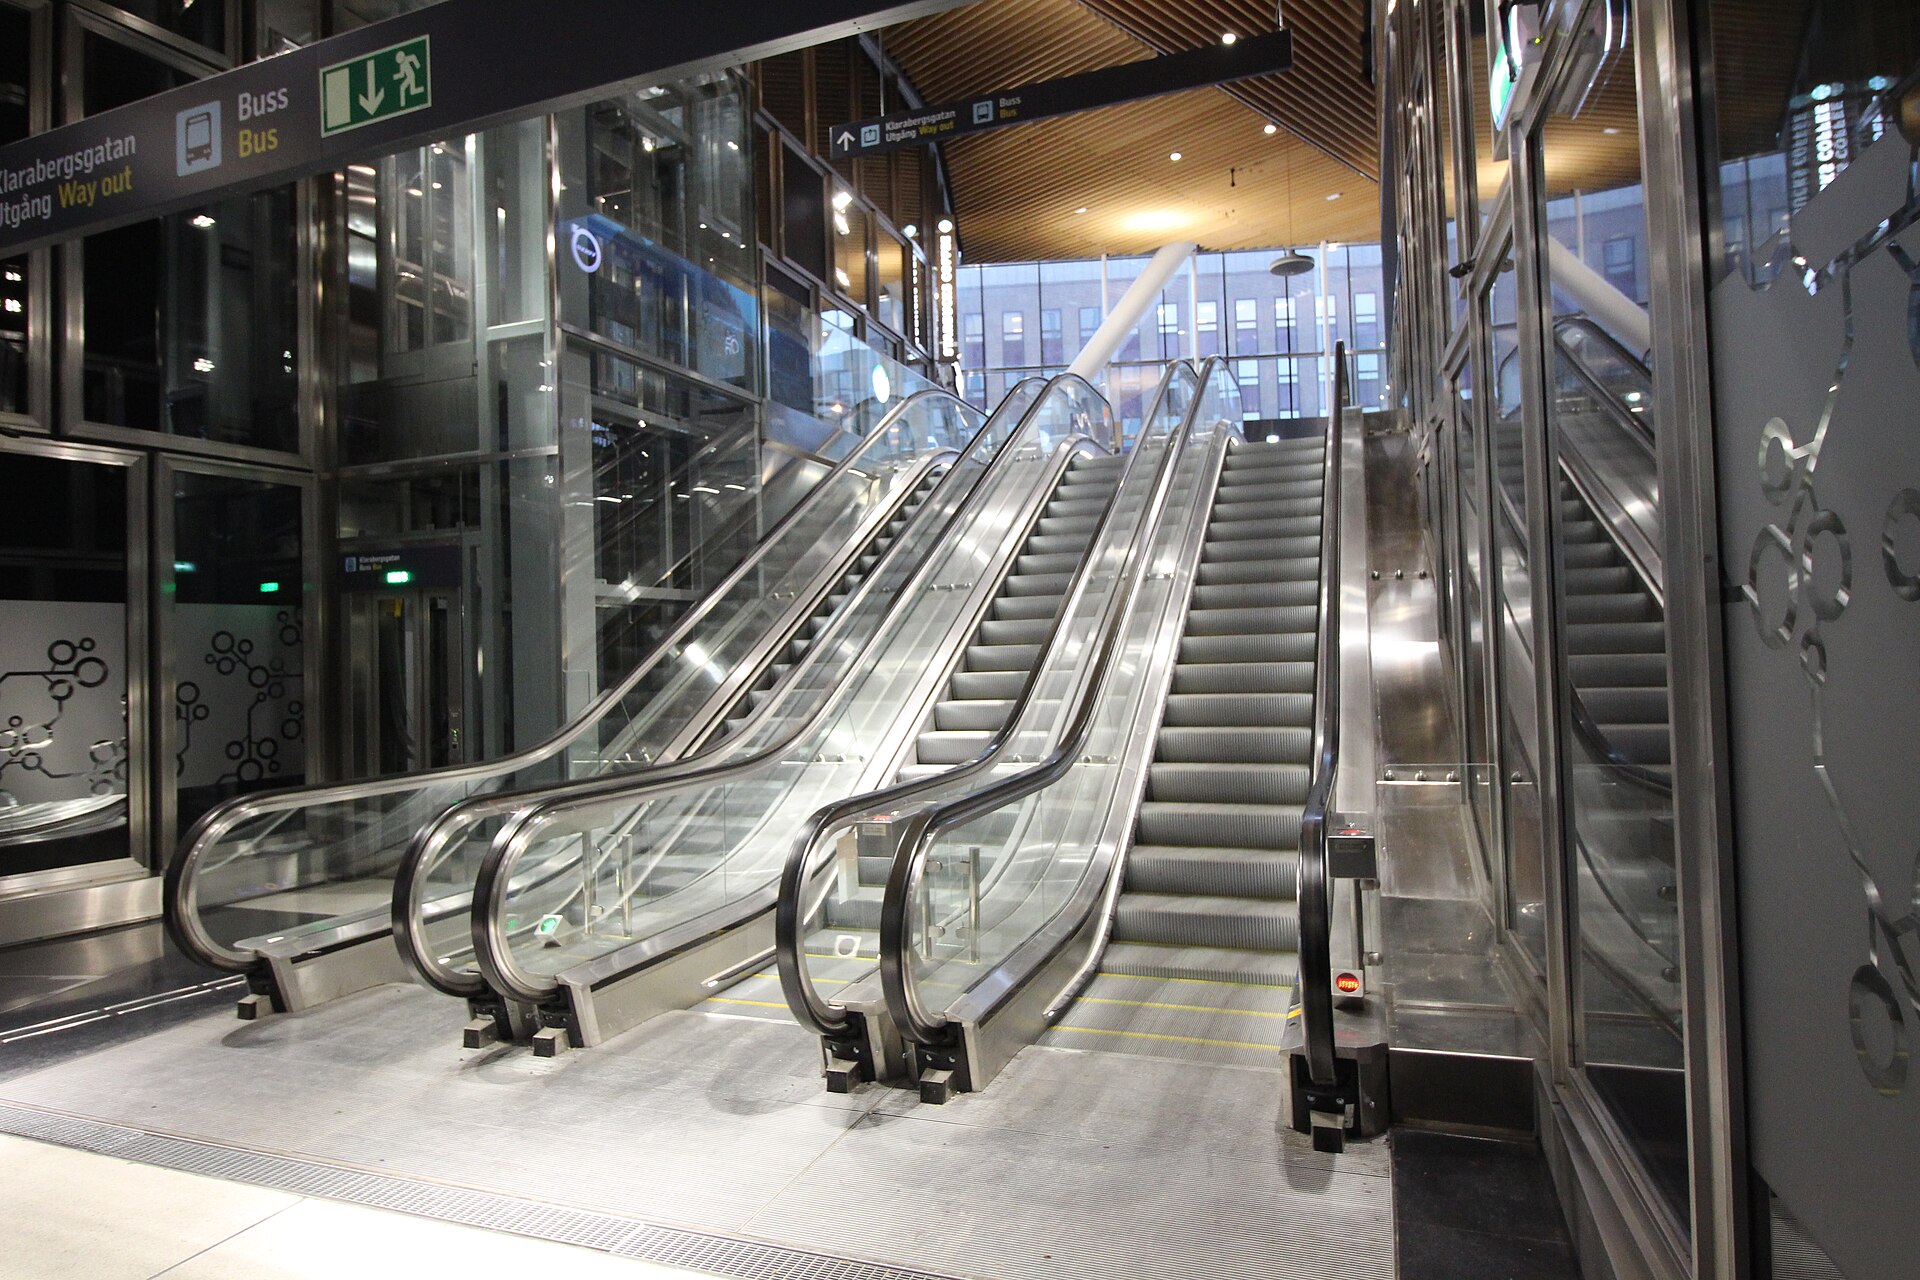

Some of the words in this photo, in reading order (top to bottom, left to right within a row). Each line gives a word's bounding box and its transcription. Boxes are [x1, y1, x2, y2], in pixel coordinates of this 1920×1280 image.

[238, 87, 289, 122] Buss
[1000, 96, 1021, 106] Buss
[885, 110, 956, 132] Klarabergsgatan
[1000, 109, 1017, 119] Bus
[238, 127, 279, 158] Bus
[885, 127, 917, 143] Utgång
[919, 125, 937, 136] Way
[940, 122, 954, 132] out
[59, 178, 97, 210] Way
[102, 165, 133, 196] out
